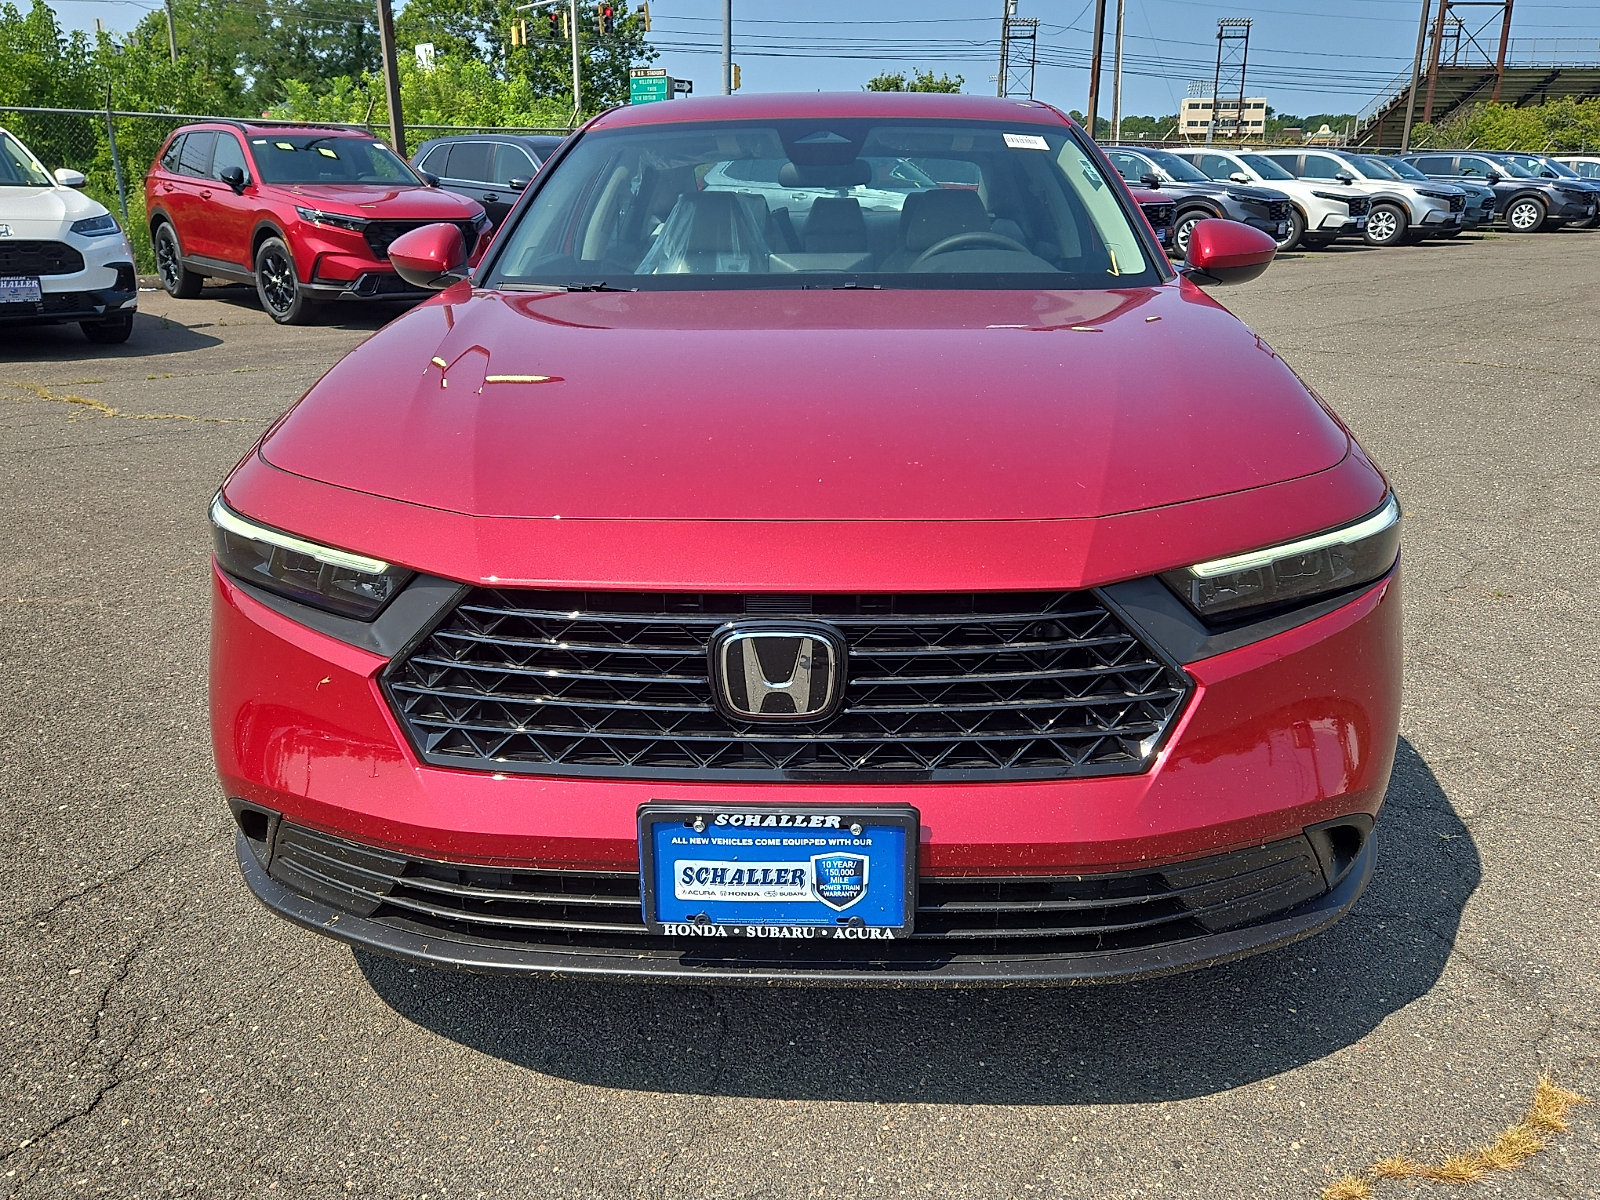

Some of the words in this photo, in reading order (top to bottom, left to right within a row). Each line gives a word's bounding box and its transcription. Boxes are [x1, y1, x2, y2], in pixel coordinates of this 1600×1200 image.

[714, 814, 841, 829] SCHALLER
[671, 837, 688, 845] ALL
[689, 837, 709, 845] NEW
[711, 838, 754, 846] VEHICLES
[755, 838, 781, 846] COME
[782, 838, 827, 847] EQUIPPED
[828, 838, 851, 846] WITH
[853, 838, 872, 846] OUR
[821, 860, 831, 868] 10
[833, 860, 857, 868] YEAR/
[824, 868, 855, 877] 150,000
[682, 866, 807, 890] SCHALLER
[830, 876, 849, 884] MILE
[663, 924, 728, 937] HONDA
[746, 925, 816, 939] SUBARU
[833, 927, 895, 940] ACURA
